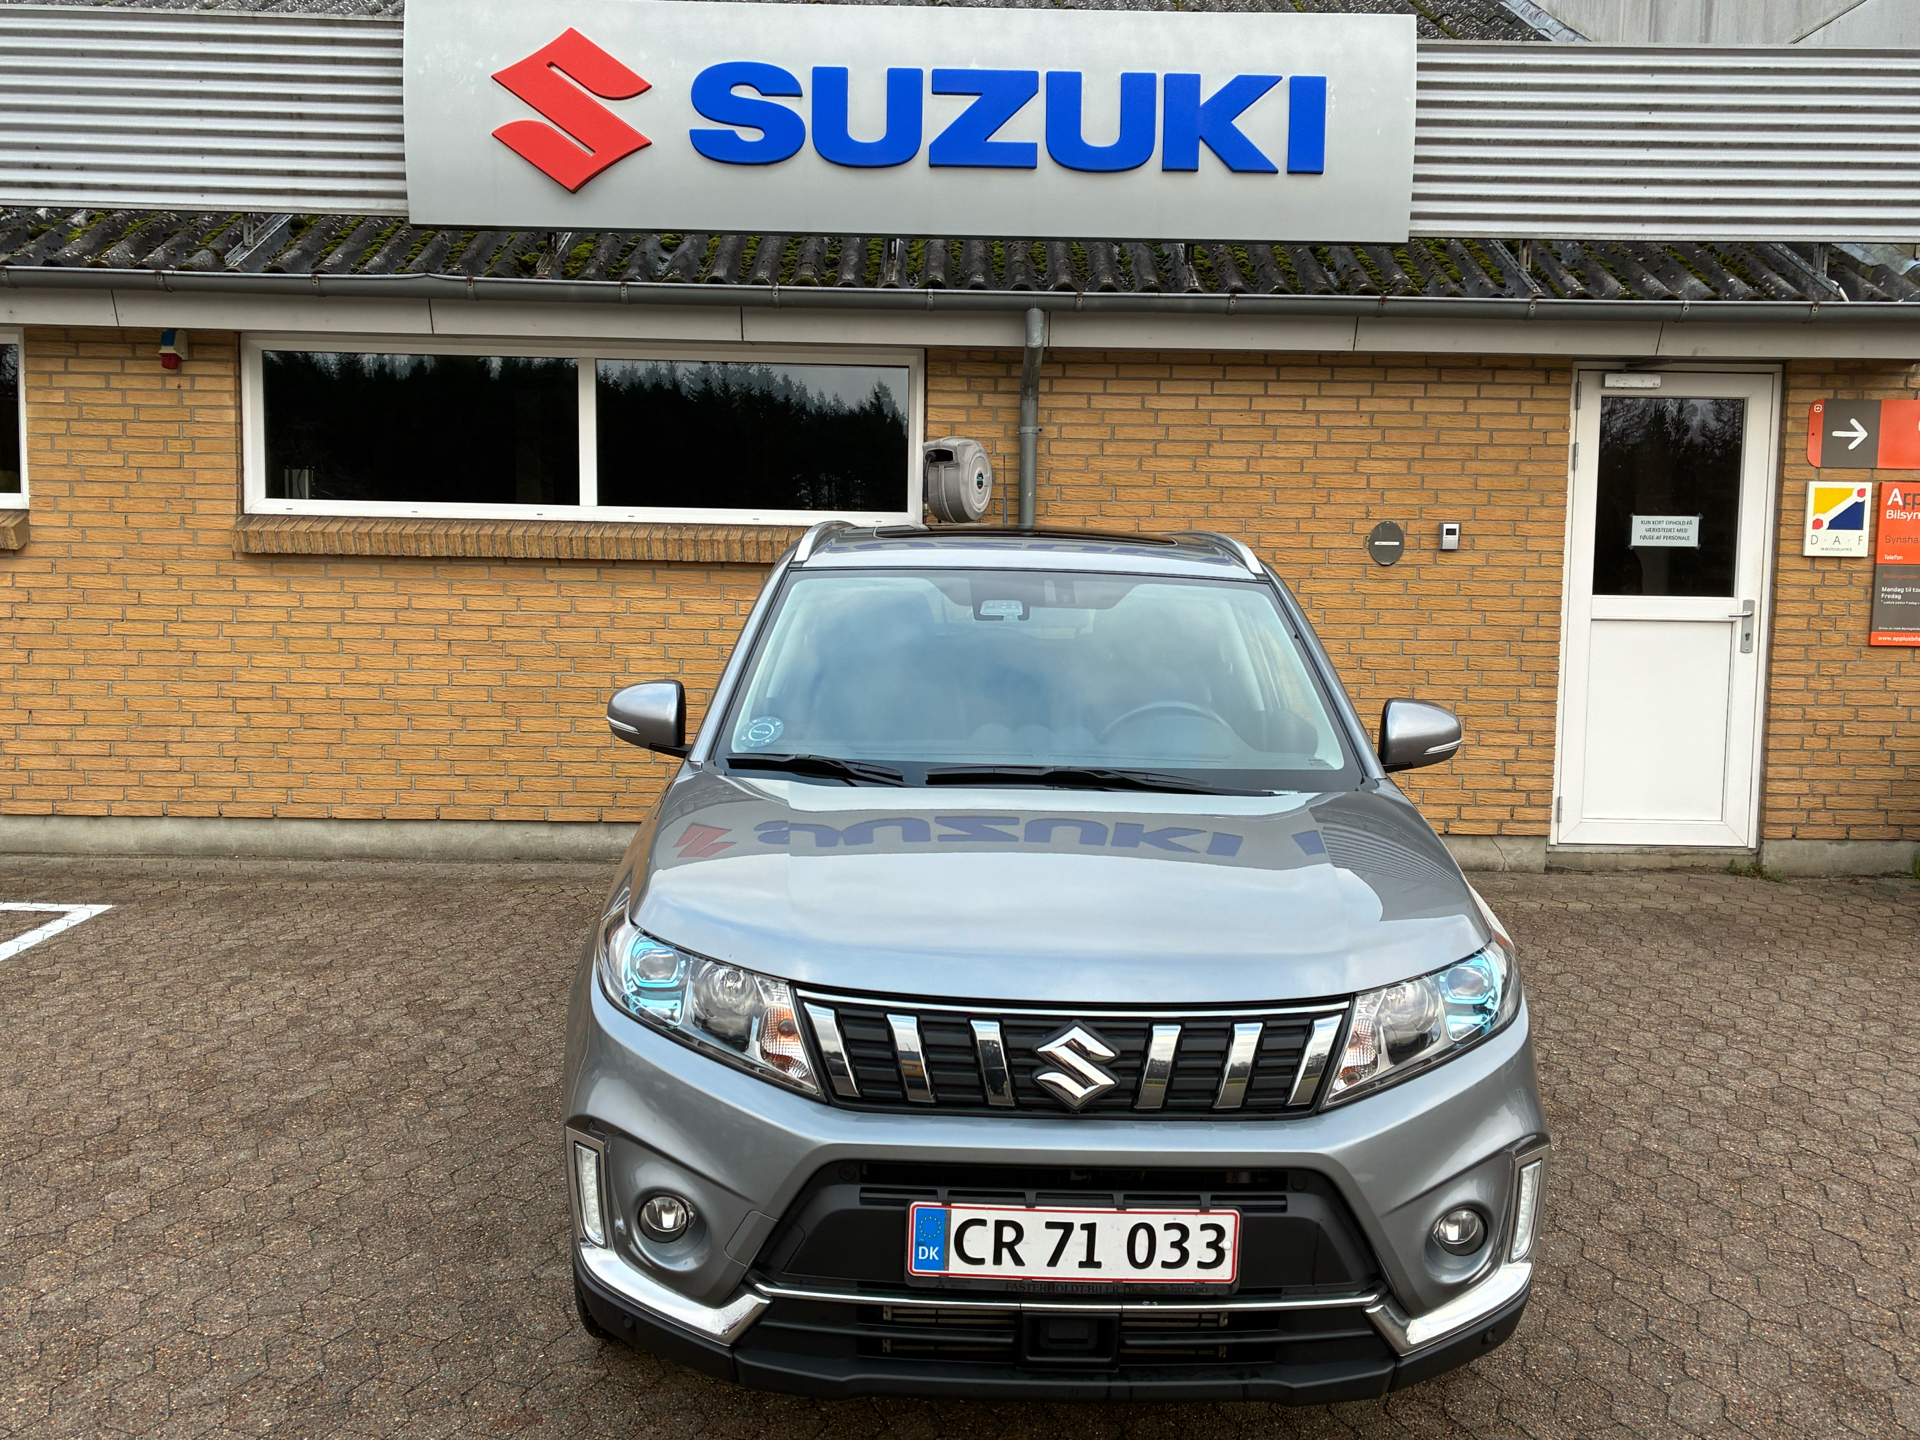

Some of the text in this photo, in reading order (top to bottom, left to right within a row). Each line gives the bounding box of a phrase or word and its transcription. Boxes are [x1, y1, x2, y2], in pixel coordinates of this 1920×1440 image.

[688, 61, 1328, 175] SUZUKI
[1884, 535, 1920, 545] Synsha
[918, 1246, 939, 1261] DK
[953, 1218, 1227, 1270] CR 71 033
